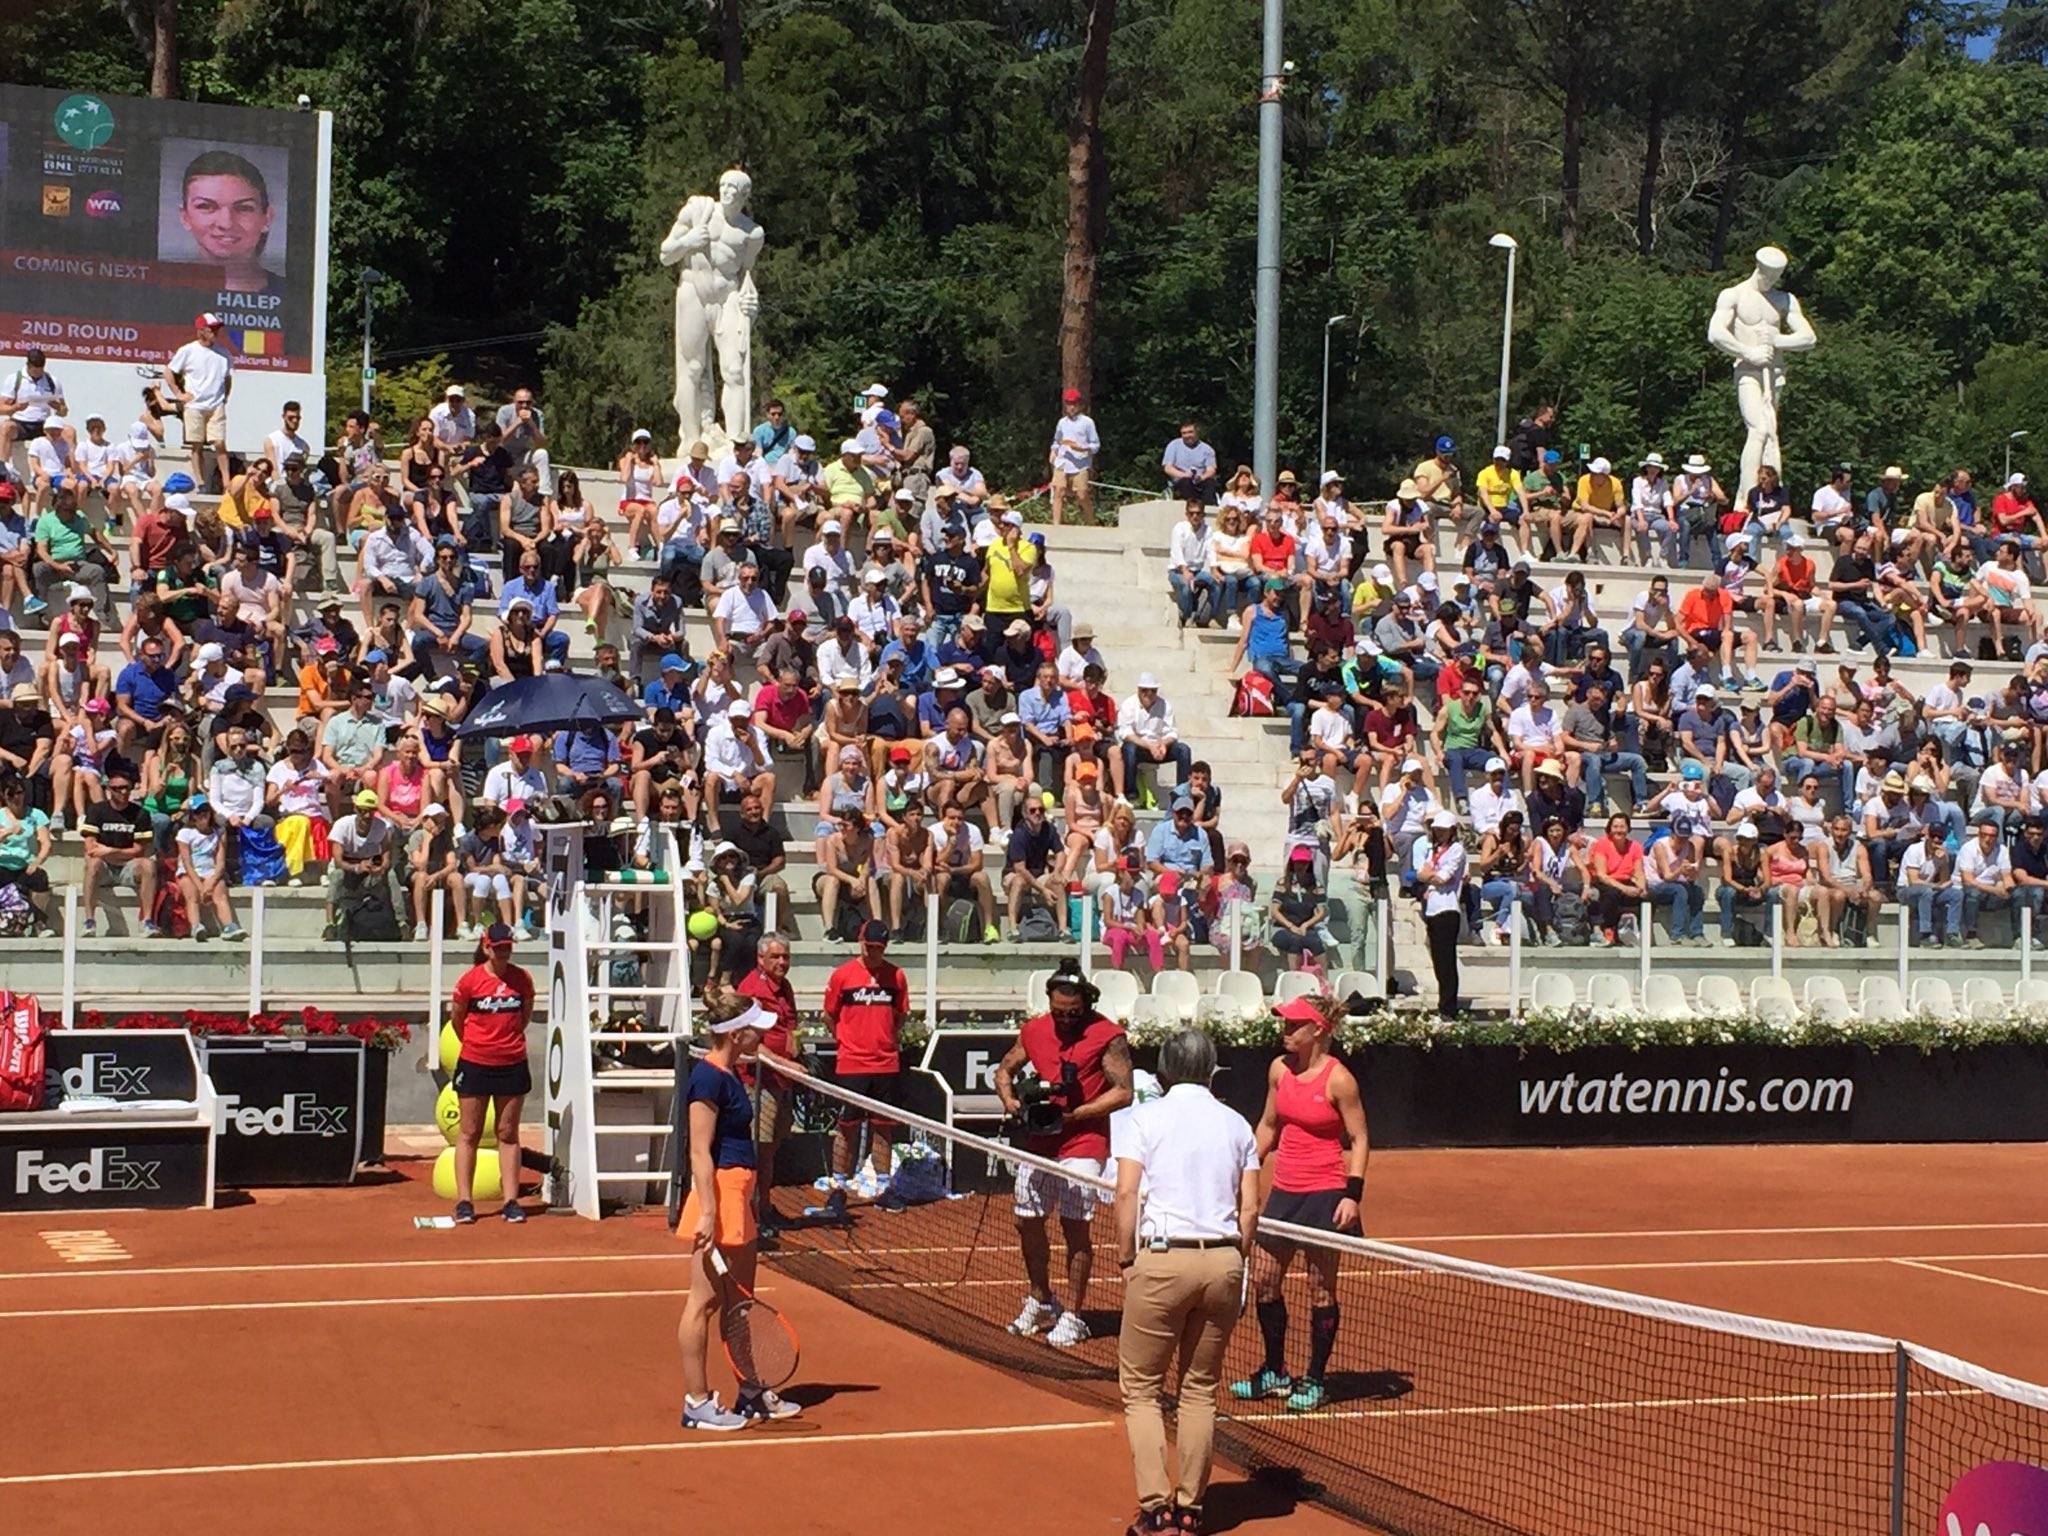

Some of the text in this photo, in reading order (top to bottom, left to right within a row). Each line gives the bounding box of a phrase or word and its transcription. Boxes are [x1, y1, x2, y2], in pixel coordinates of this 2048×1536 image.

[87, 198, 121, 212] WTA
[13, 256, 150, 280] COMING NEXT
[216, 291, 282, 310] HALEP
[21, 320, 139, 342] 2ND ROUND
[9, 1009, 30, 1073] Wilson
[1519, 1066, 1854, 1114] wtatennis.com
[215, 1093, 349, 1136] FedEx
[15, 1147, 162, 1194] FedEx
